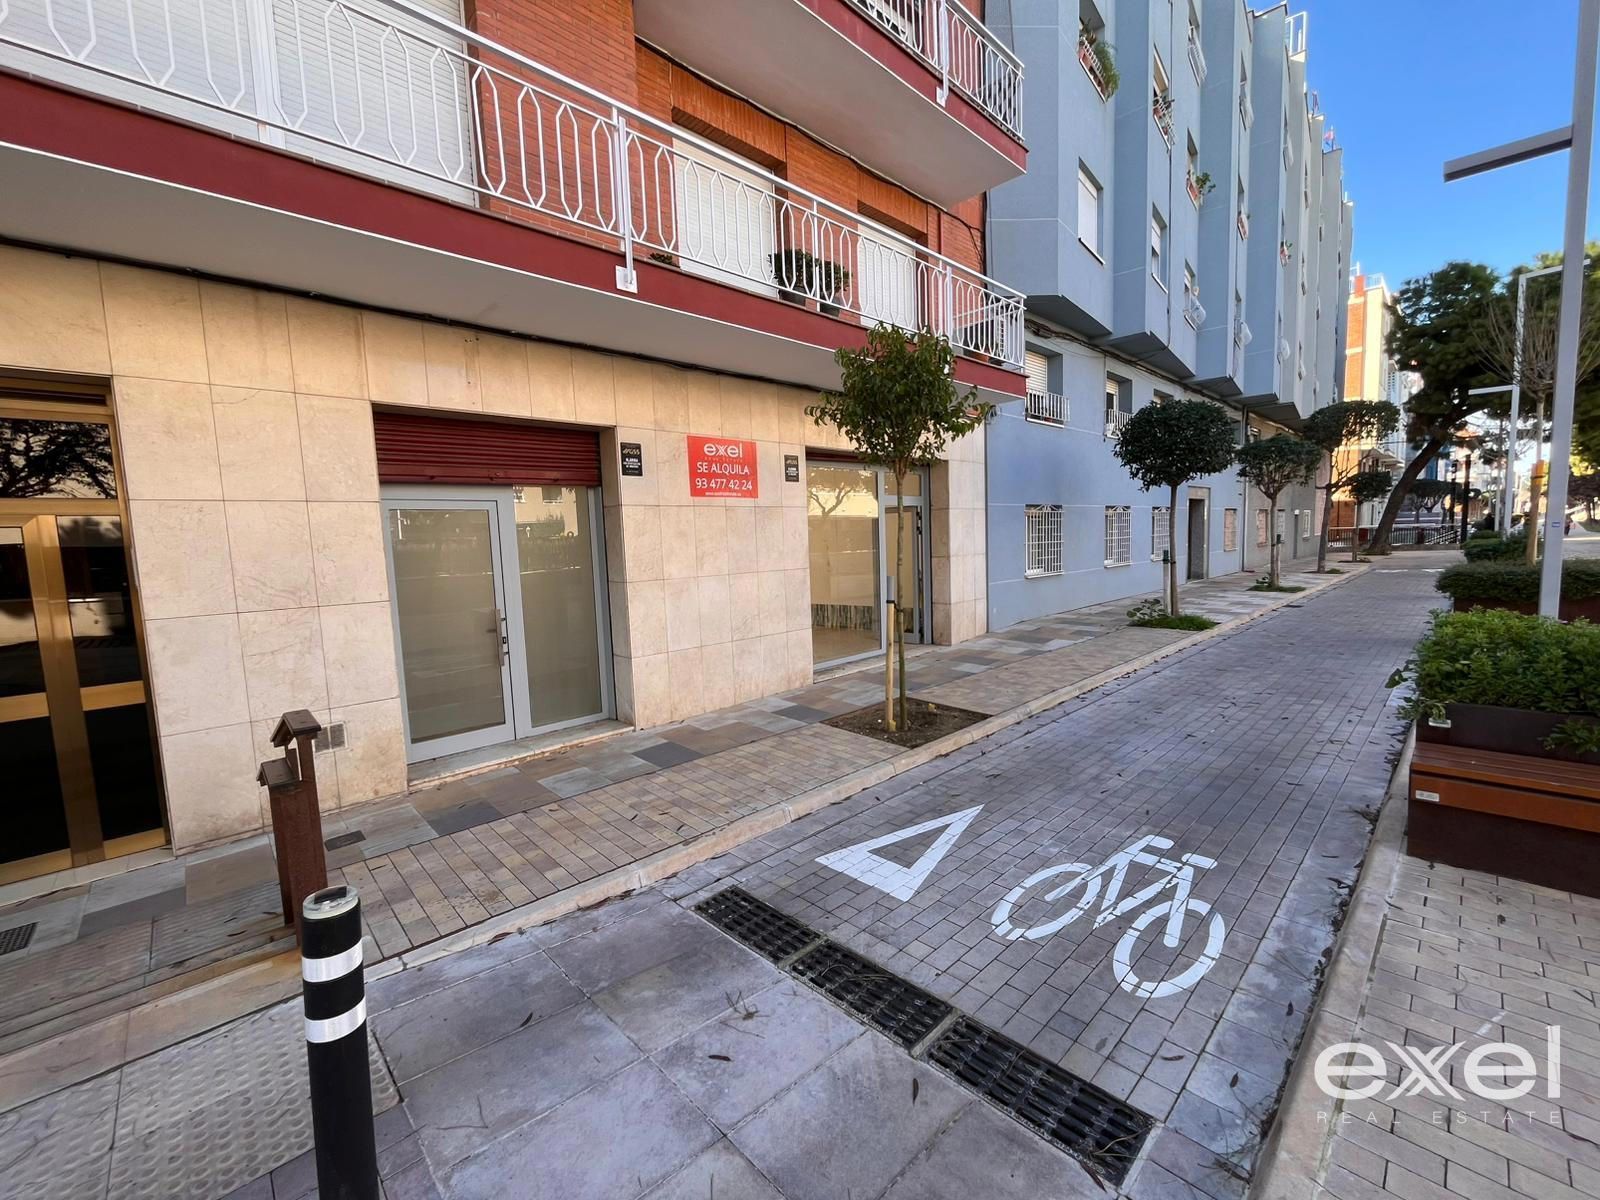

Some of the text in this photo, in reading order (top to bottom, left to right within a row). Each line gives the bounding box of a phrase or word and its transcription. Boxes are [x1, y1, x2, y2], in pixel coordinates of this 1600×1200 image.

[703, 442, 743, 457] exel
[696, 461, 750, 475] SE ALQUILA
[695, 477, 752, 490] 93 477 42 24
